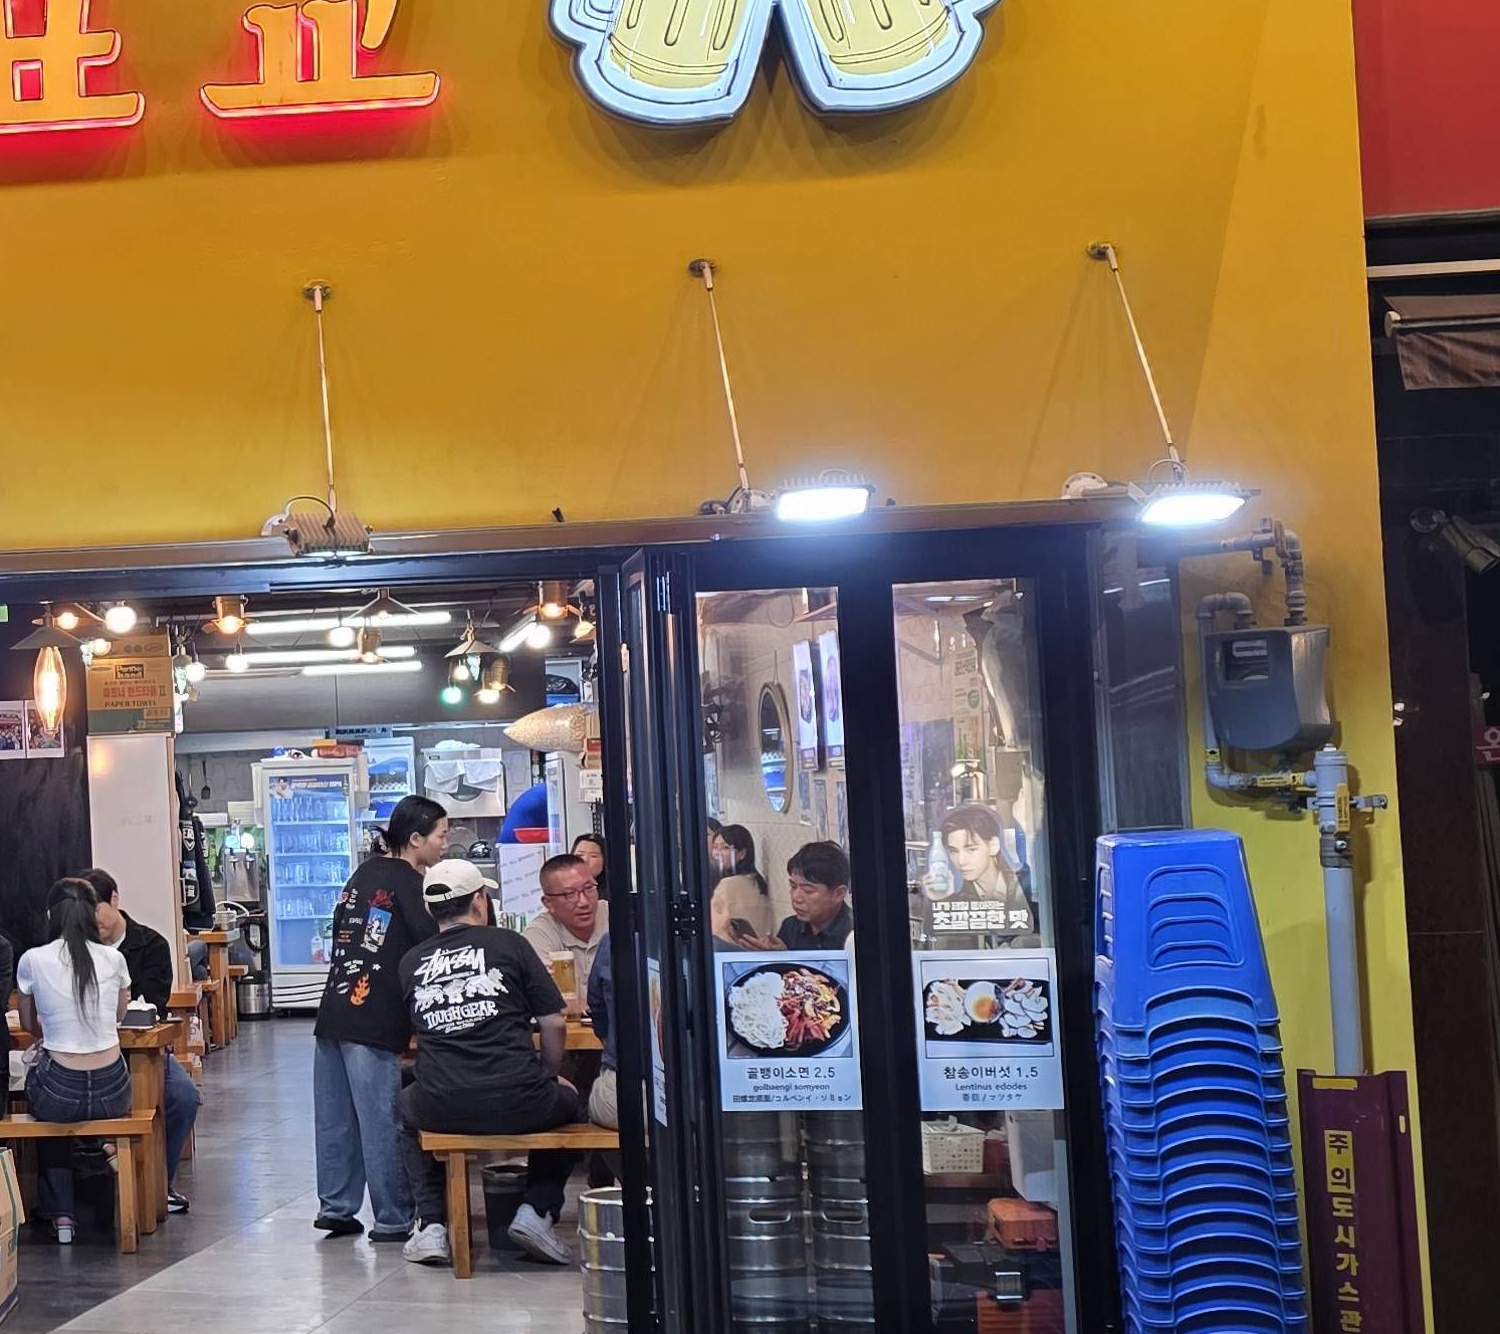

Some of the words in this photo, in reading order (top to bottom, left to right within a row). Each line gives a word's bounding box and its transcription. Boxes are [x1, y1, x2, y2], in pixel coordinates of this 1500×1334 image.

[1009, 909, 1029, 929] 맛
[747, 1067, 810, 1080] 골뱅이소면
[814, 1067, 836, 1079] 2.5
[944, 1066, 1011, 1080] 참송이버섯
[1016, 1066, 1039, 1079] 1.5
[753, 1083, 793, 1093] golbaengi
[794, 1083, 830, 1092] somyeon
[955, 1083, 993, 1091] Lentinus
[995, 1082, 1028, 1091] edodes
[1331, 1196, 1363, 1334] 도시가스관
